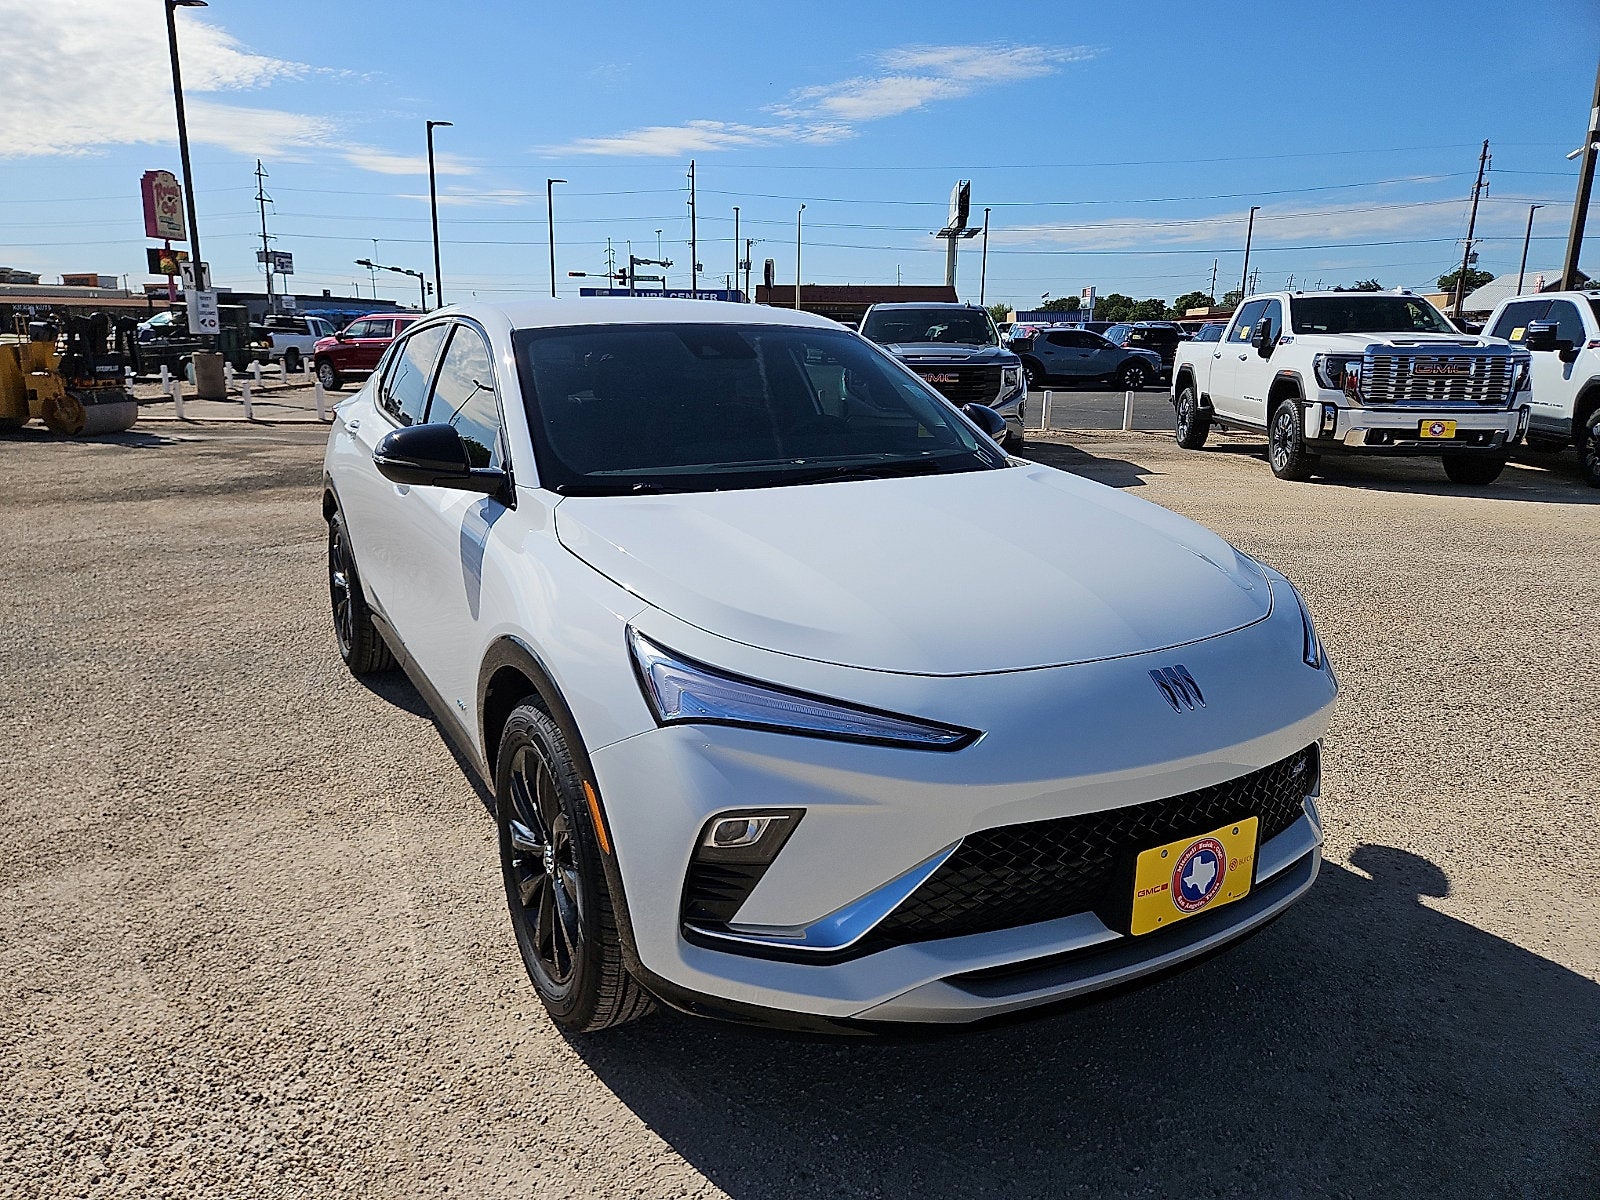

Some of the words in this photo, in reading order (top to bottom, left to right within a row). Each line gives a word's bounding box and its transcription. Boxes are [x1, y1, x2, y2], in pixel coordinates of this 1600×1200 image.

[670, 292, 718, 301] CENTER
[1414, 363, 1470, 374] GMC
[1137, 885, 1161, 898] GMC
